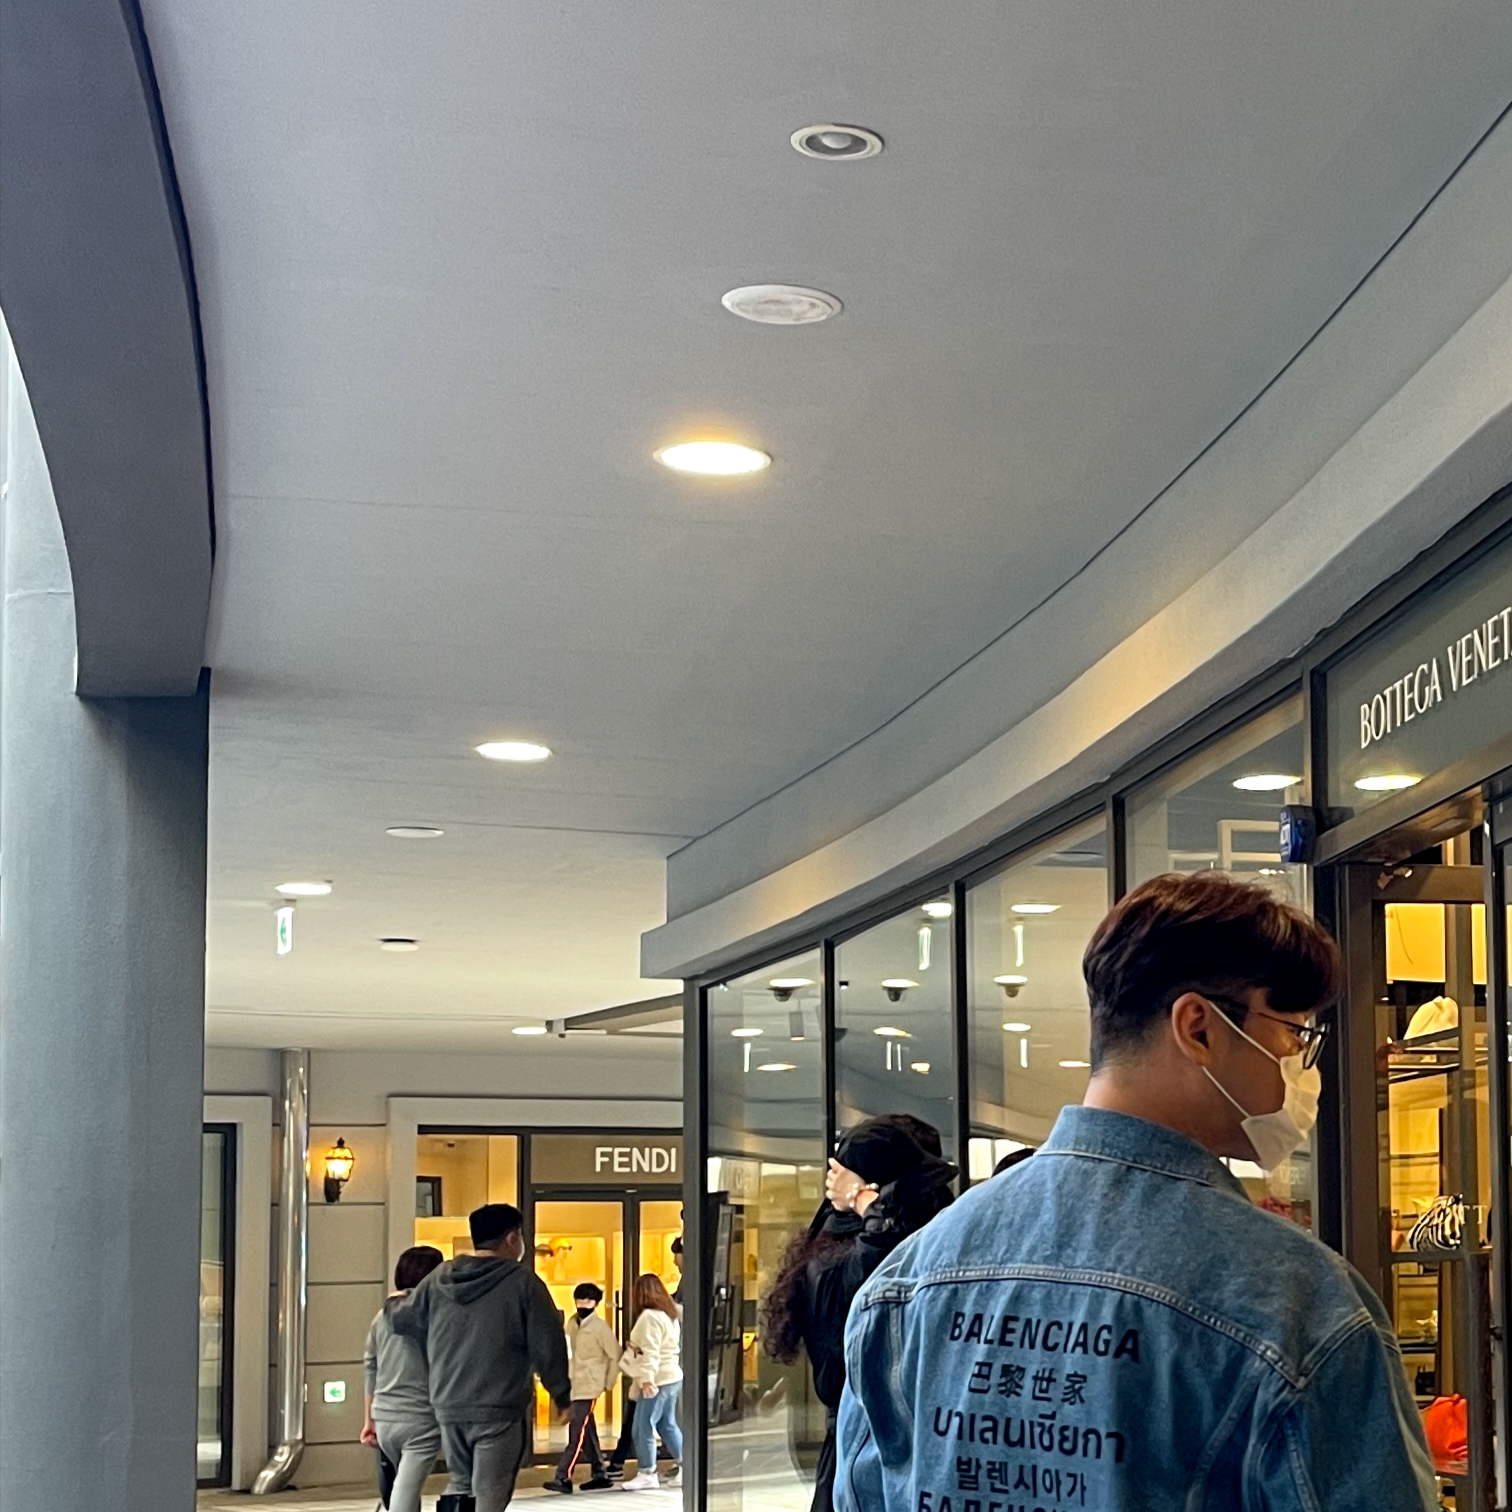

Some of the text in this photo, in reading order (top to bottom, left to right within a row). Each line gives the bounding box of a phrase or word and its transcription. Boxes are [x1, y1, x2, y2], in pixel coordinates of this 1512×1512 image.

[1360, 657, 1443, 749] BOTTEGA
[595, 1147, 677, 1173] FENDI
[949, 1311, 1140, 1363] BALENCIAGA
[968, 1361, 1088, 1406] 巴黎世家
[956, 1456, 1087, 1506] 발렌시아가
